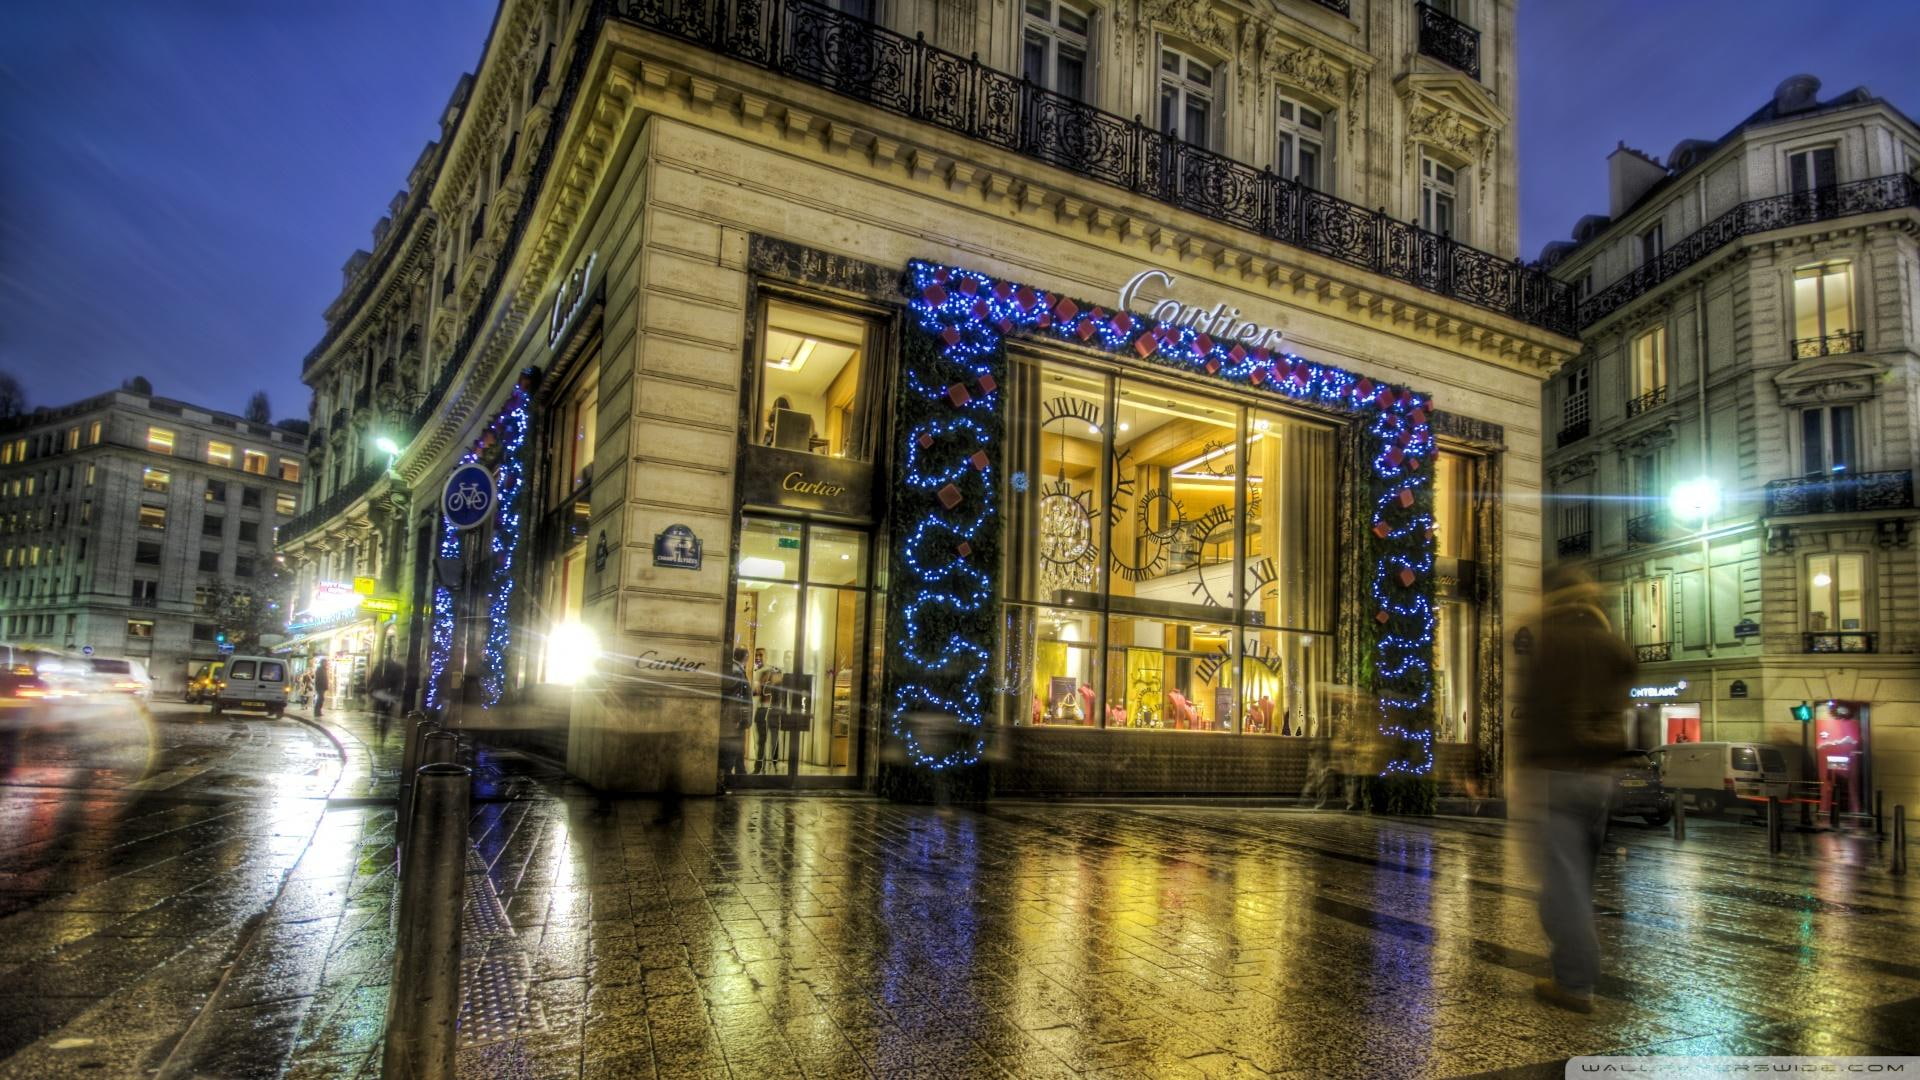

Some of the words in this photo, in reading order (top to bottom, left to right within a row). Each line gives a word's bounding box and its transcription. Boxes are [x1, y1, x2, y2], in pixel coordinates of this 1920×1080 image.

[1119, 269, 1283, 348] Cartier
[782, 471, 845, 497] Cartier
[636, 650, 706, 672] Cartier
[1630, 686, 1679, 698] ONTBLANC
